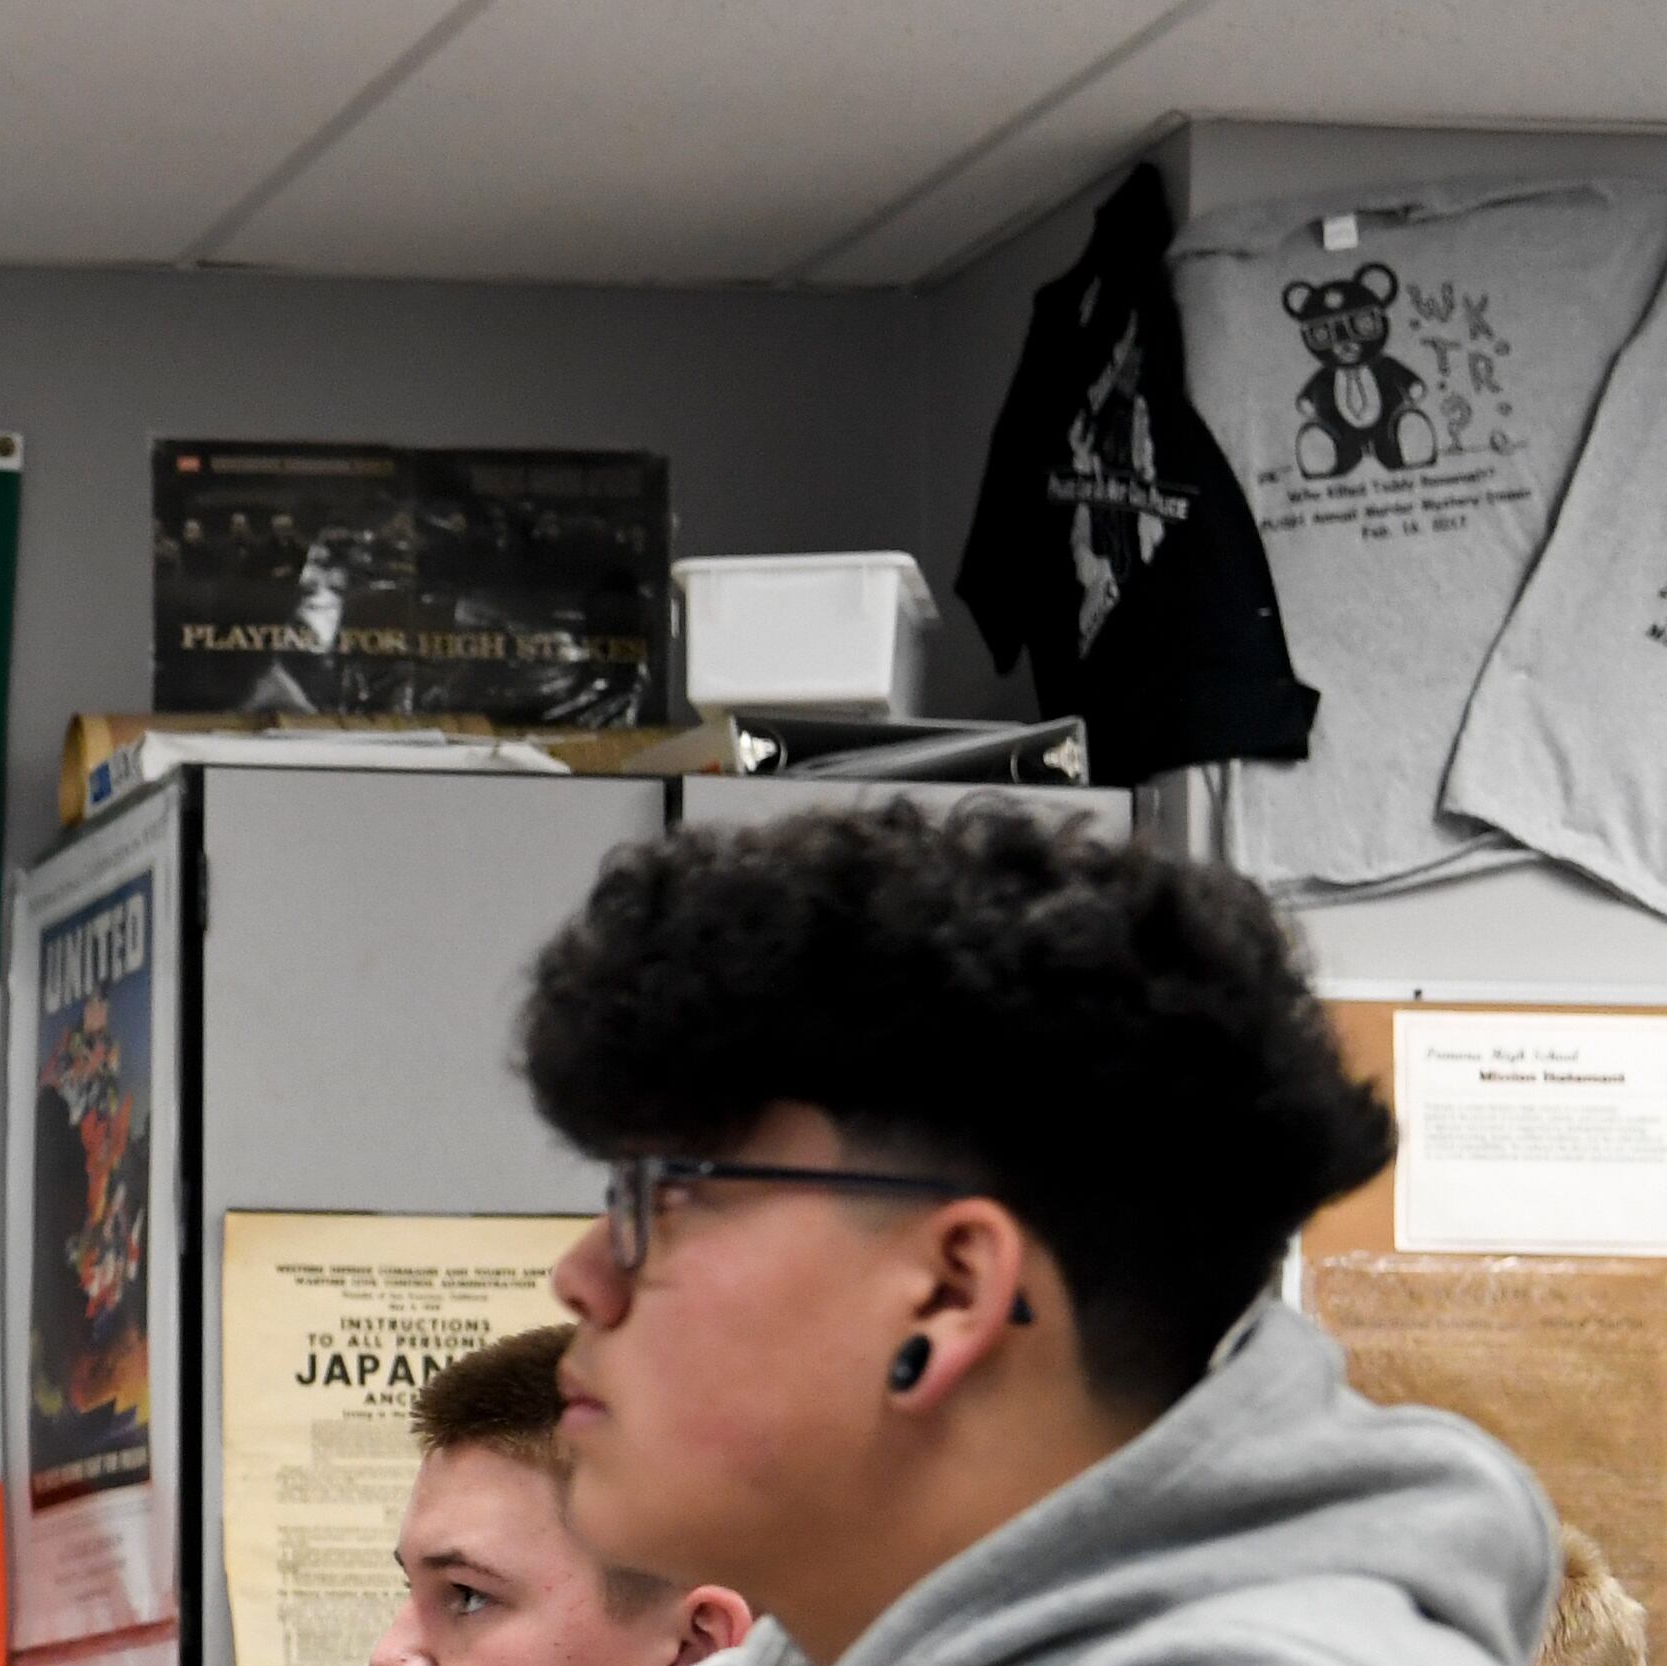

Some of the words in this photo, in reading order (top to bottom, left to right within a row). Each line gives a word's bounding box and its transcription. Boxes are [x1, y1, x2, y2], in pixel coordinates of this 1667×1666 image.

[339, 627, 408, 656] FOR
[417, 630, 506, 661] HIGH
[44, 892, 145, 1014] UNITED
[308, 1333, 334, 1349] TO
[347, 1333, 382, 1349] ALL
[395, 1333, 487, 1349] PERSONS
[340, 1316, 491, 1333] INSTRUCTIONS
[295, 1353, 455, 1387] JAPAN
